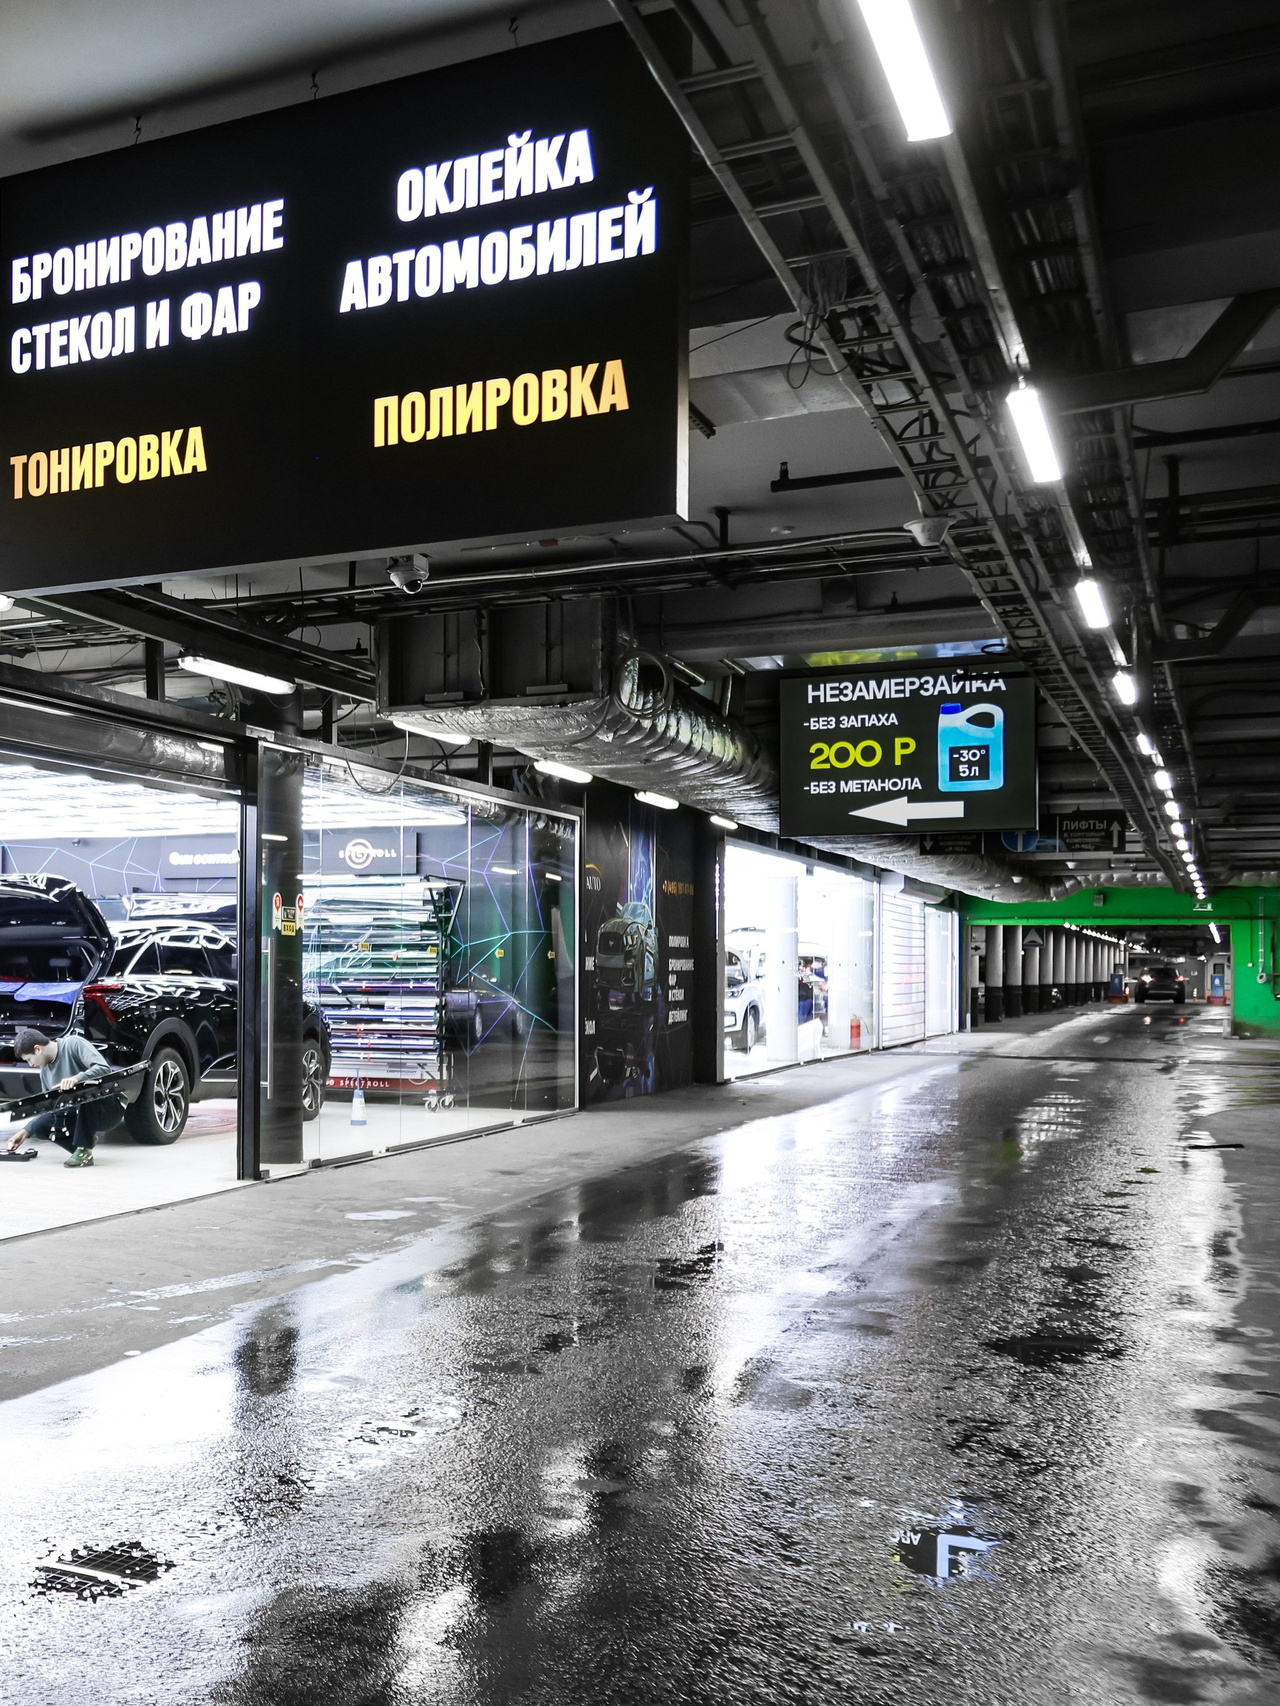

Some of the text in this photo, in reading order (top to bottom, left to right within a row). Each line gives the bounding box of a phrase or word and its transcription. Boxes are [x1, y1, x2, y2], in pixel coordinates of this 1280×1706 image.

[397, 129, 594, 222] ОКЛЕЙКА
[11, 199, 285, 303] БРОНИРОВАНИЕ
[340, 187, 657, 313] АВТОМОБИЛЕЙ
[10, 281, 262, 374] СТЕКОЛ И ФАР
[373, 359, 629, 448] ПОЛИРОВКА
[10, 426, 207, 499] ТОНИРОВКА
[803, 713, 898, 730] -БЕЗ ЗАПАХА
[807, 669, 1006, 703] НЕЗАМЕРЗАЙКА
[803, 777, 922, 794] -БЕЗ МЕТАНОЛА
[809, 740, 882, 769] 200
[1062, 819, 1107, 831] ЛИФТЫ
